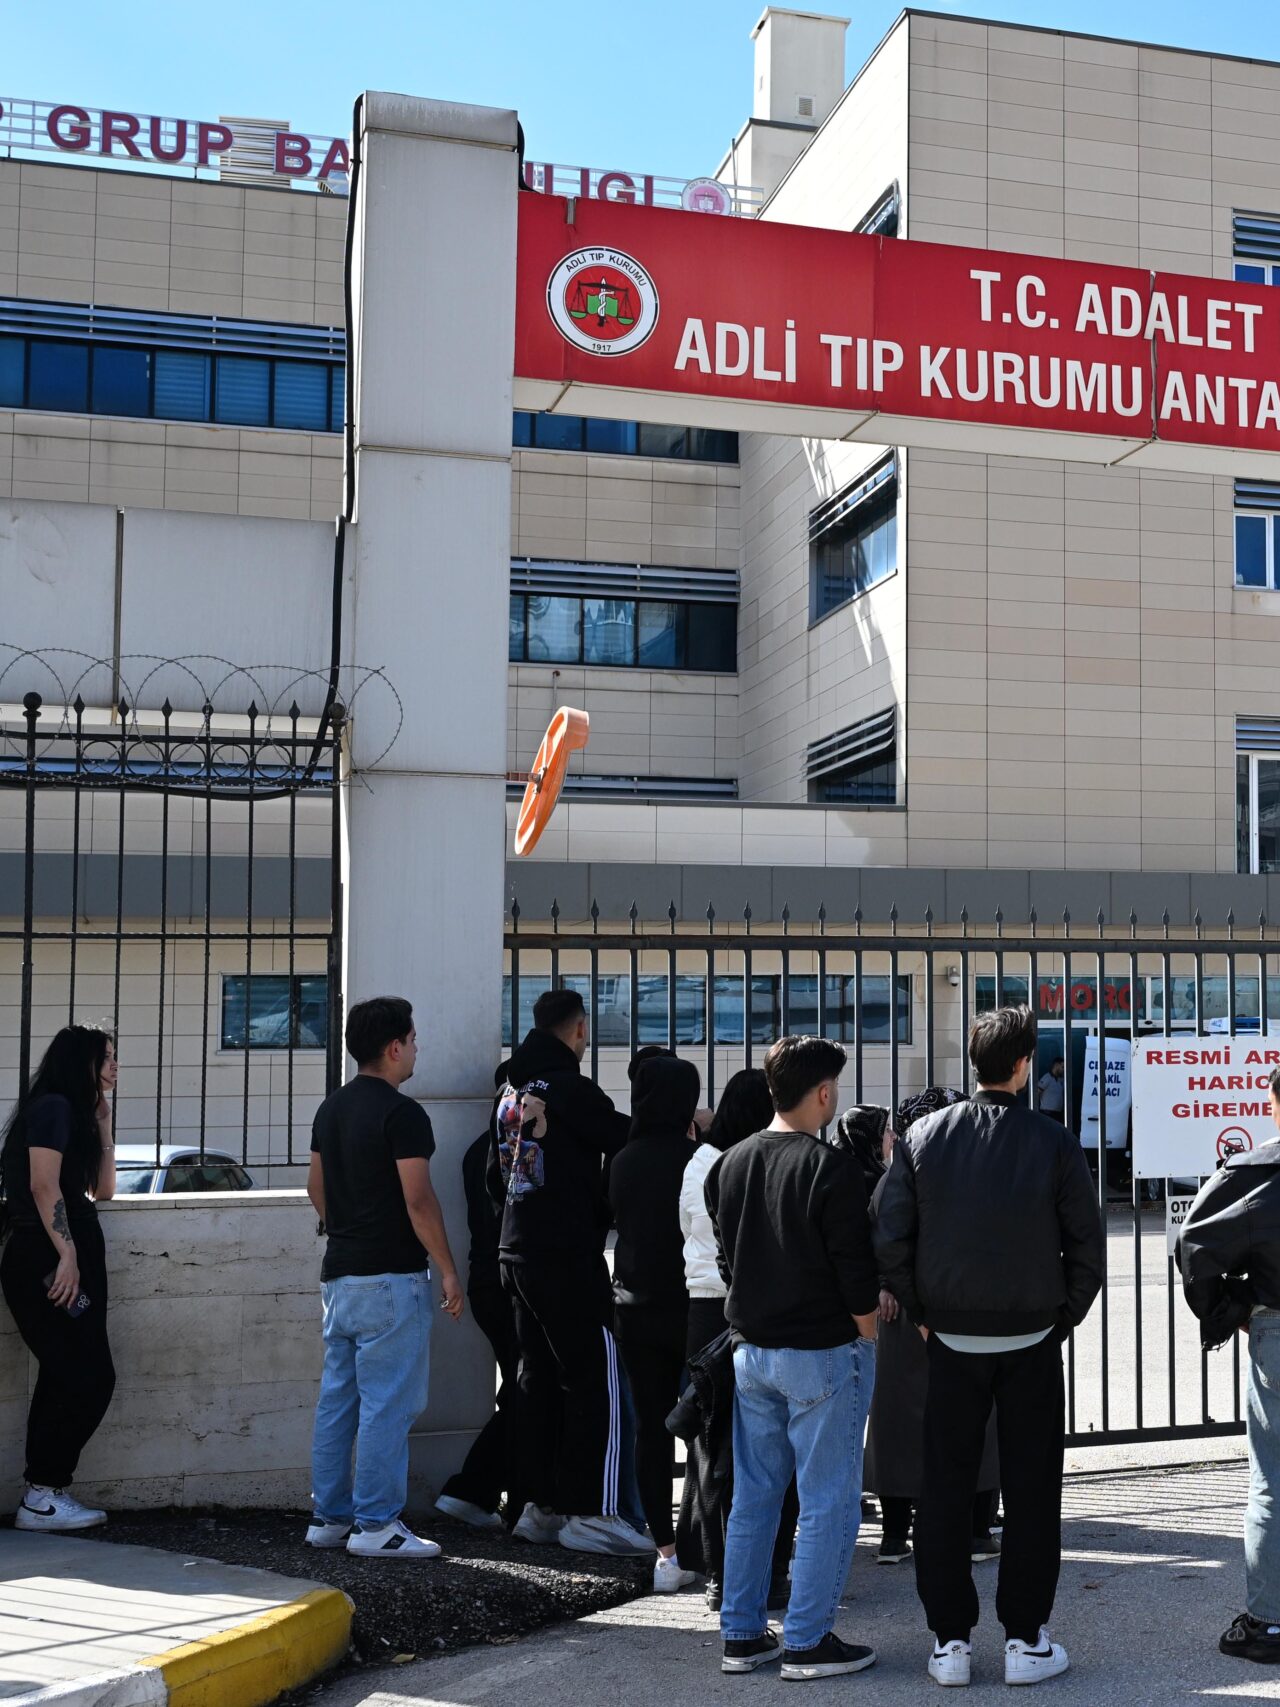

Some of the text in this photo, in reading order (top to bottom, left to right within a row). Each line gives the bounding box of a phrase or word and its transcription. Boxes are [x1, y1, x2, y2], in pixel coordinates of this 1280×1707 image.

[47, 105, 234, 166] GRUP
[565, 252, 647, 287] ADLİ TIP KURUMU
[970, 269, 1059, 329] T.C.
[1075, 283, 1263, 353] ADALET
[592, 343, 612, 352] 1917
[674, 317, 797, 383] ADLİ
[819, 333, 904, 392] TIP
[920, 345, 1143, 417] KURUMU
[1146, 1046, 1231, 1065] RESMİ
